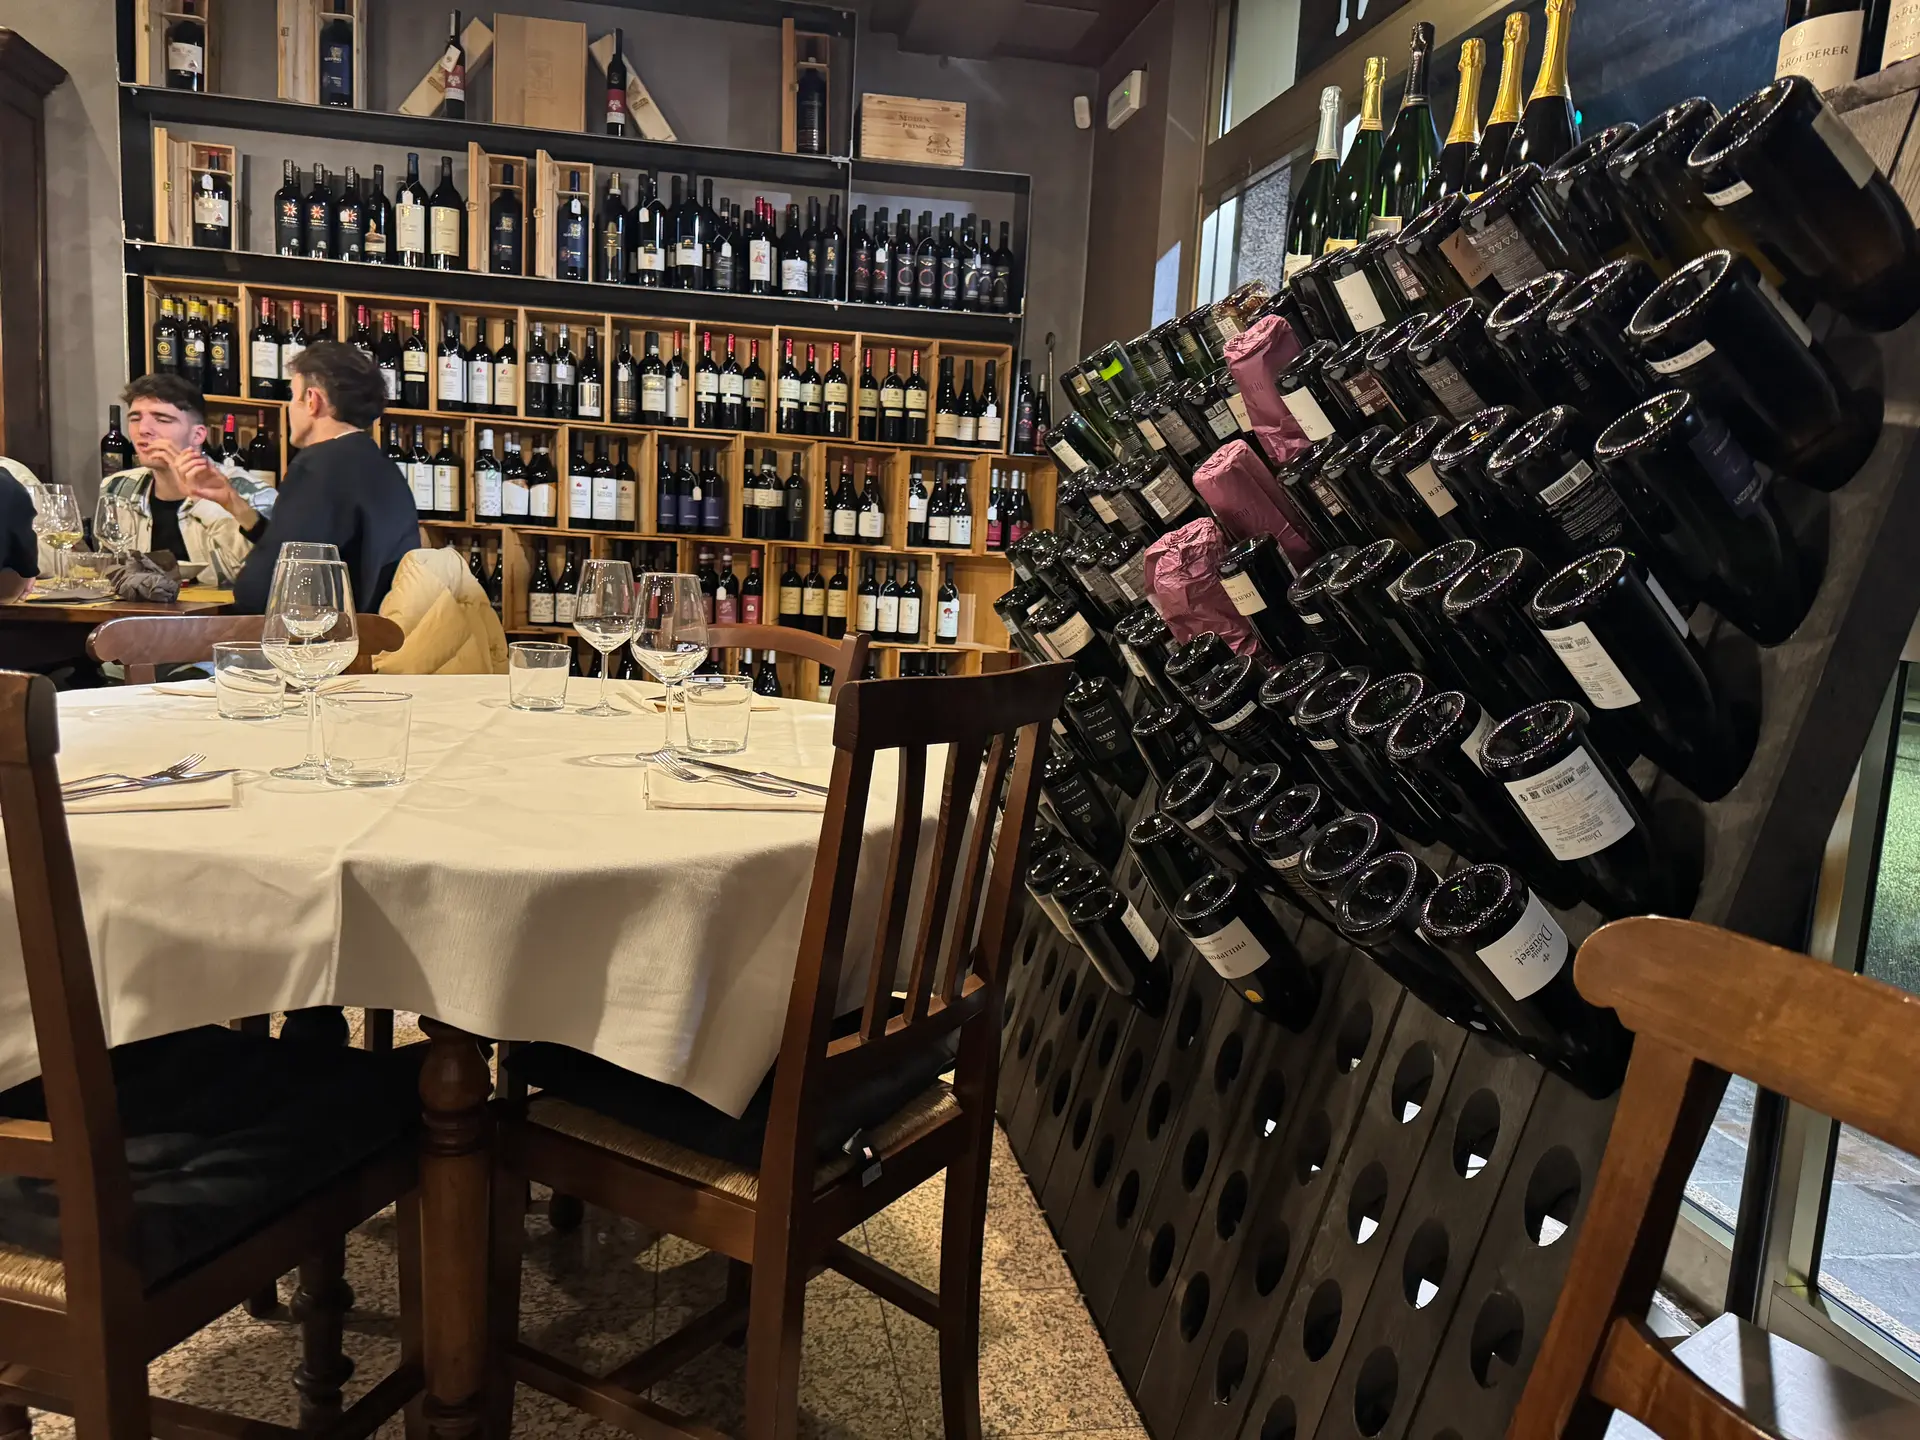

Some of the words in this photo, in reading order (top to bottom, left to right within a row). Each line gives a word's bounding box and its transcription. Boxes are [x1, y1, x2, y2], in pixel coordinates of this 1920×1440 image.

[1785, 45, 1849, 67] ROEDERER
[1514, 924, 1553, 965] Dousset
[1531, 939, 1549, 959] Louis
